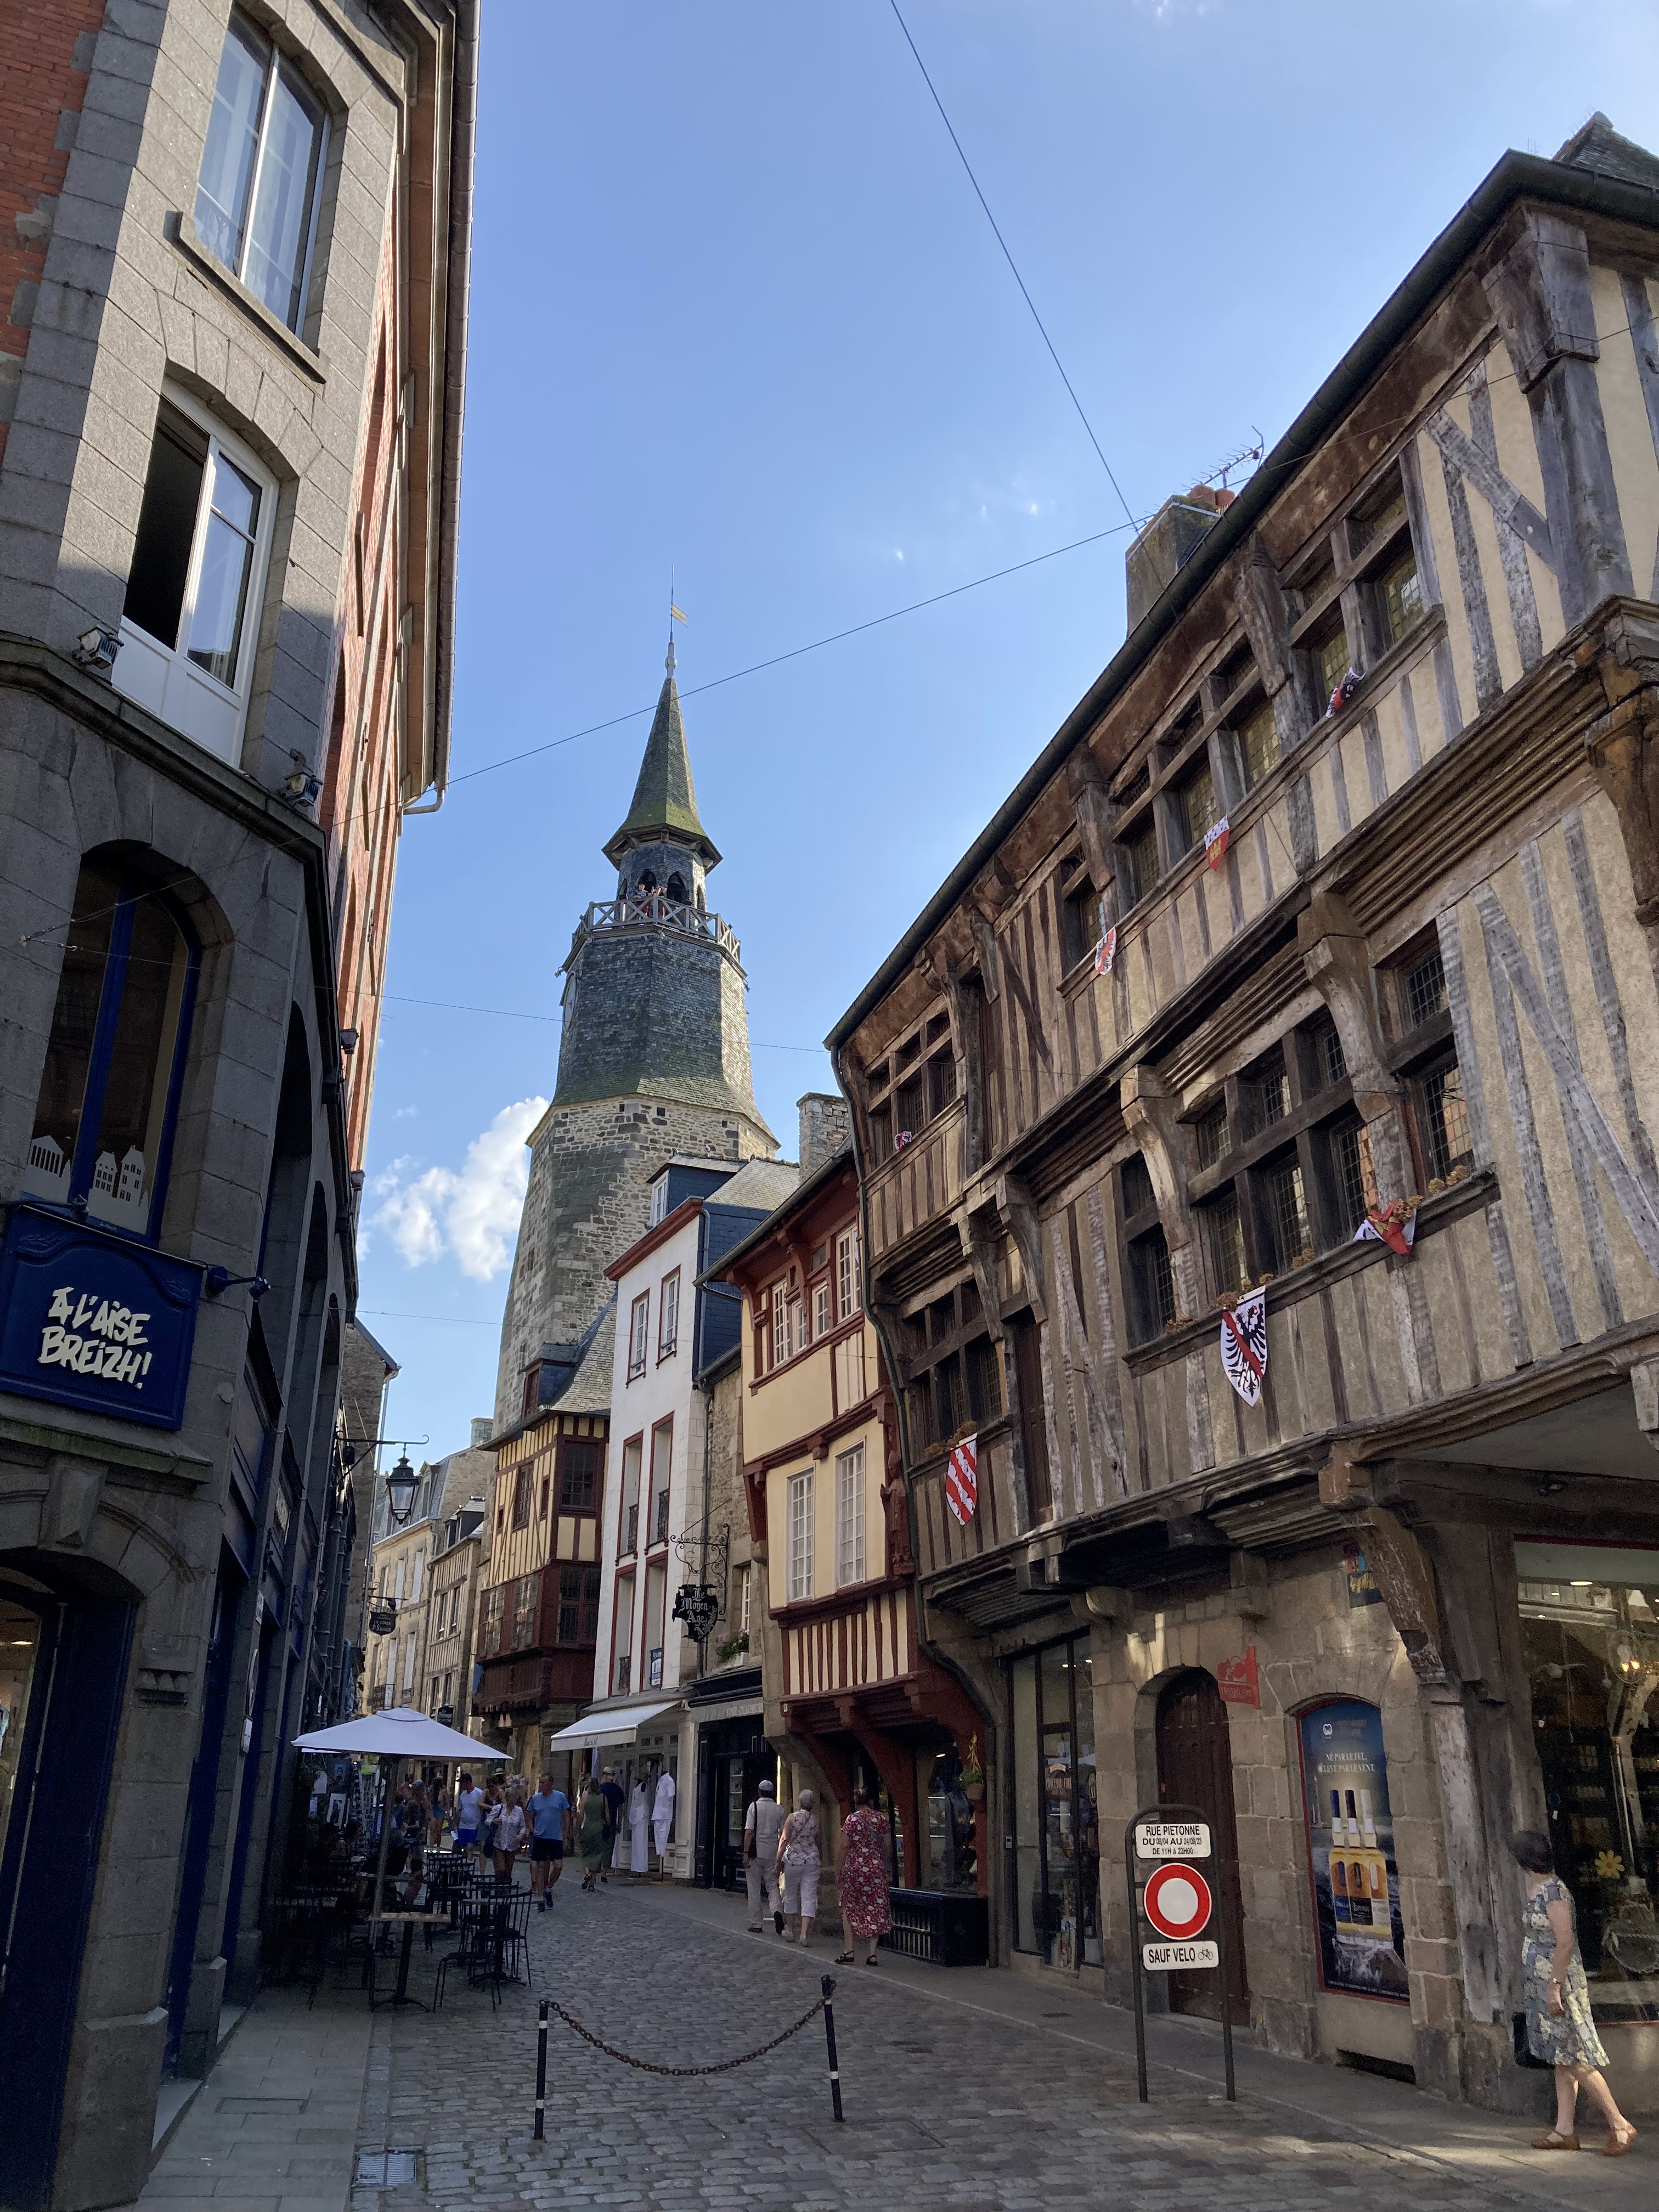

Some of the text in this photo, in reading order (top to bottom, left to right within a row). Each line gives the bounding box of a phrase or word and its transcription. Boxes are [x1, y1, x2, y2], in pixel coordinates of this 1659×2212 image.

[678, 1598, 709, 1614] Moyen
[1146, 1825, 1200, 1836] RUE PIETONNE
[1148, 1947, 1195, 1963] SAUF VELO
